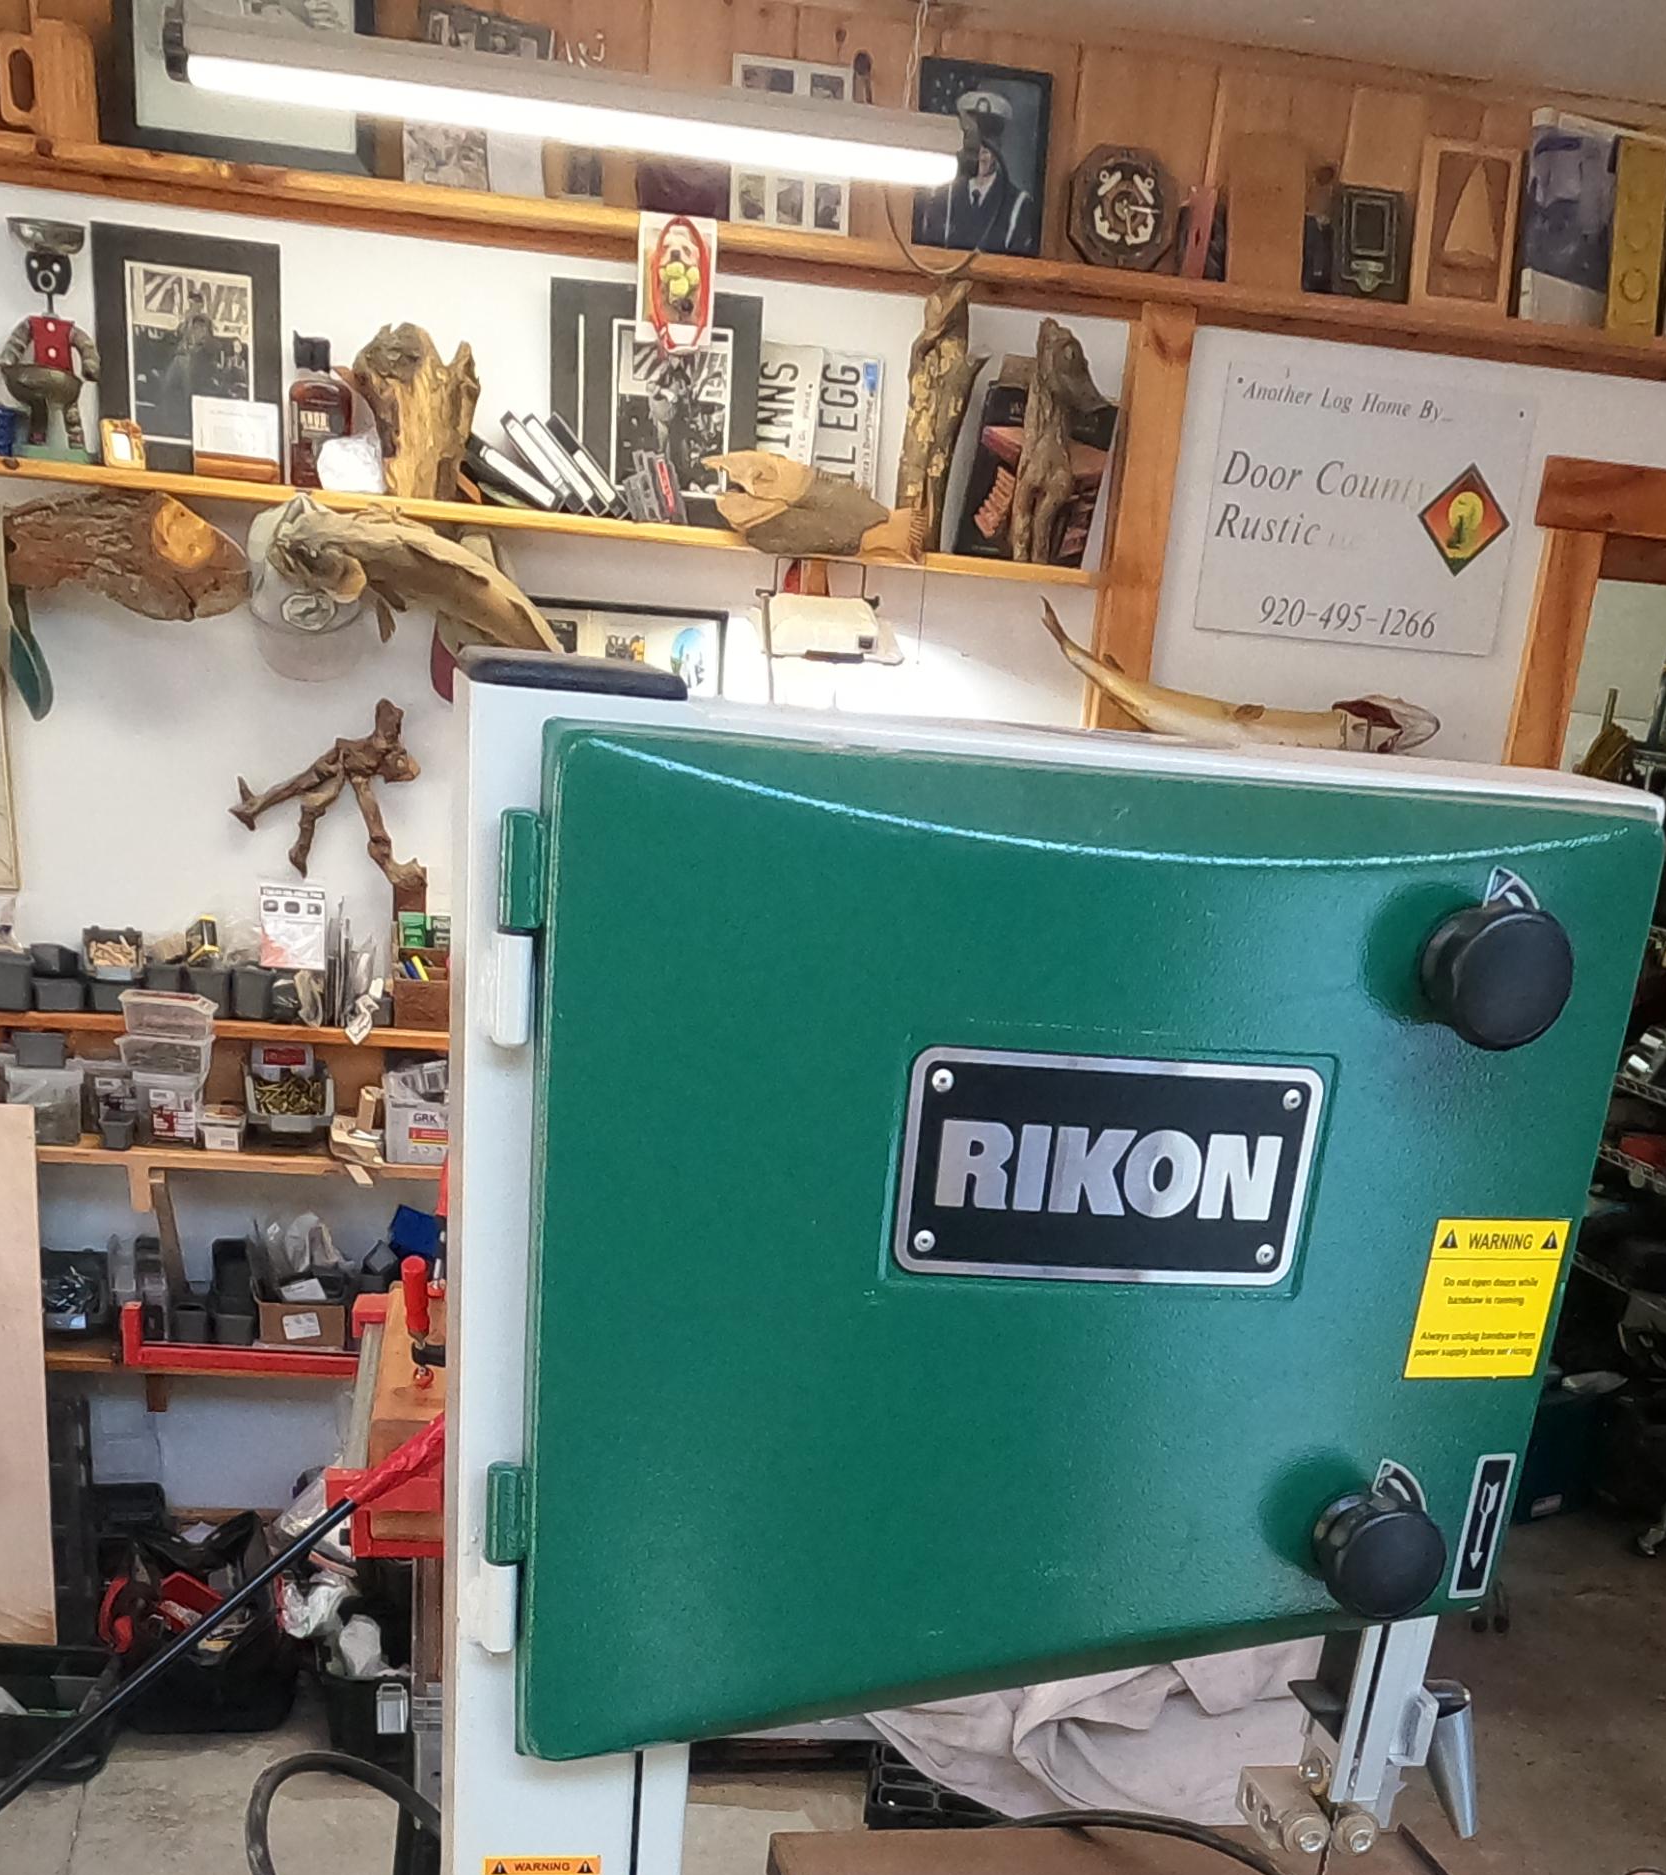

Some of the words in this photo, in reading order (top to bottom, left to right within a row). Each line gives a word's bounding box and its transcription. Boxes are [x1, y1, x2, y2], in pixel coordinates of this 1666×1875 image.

[818, 363, 860, 431] EGG
[1242, 380, 1313, 407] Another
[1321, 387, 1353, 413] Log
[1361, 392, 1412, 418] Home
[1221, 450, 1303, 492] Door
[1214, 503, 1322, 546] Rustic
[1257, 595, 1438, 639] 920-495-1266
[413, 1112, 438, 1123] GRK
[934, 1119, 1283, 1222] RIKON
[1468, 1233, 1534, 1250] WARNING
[1443, 1276, 1455, 1287] Do
[514, 1862, 571, 1872] WARNING
